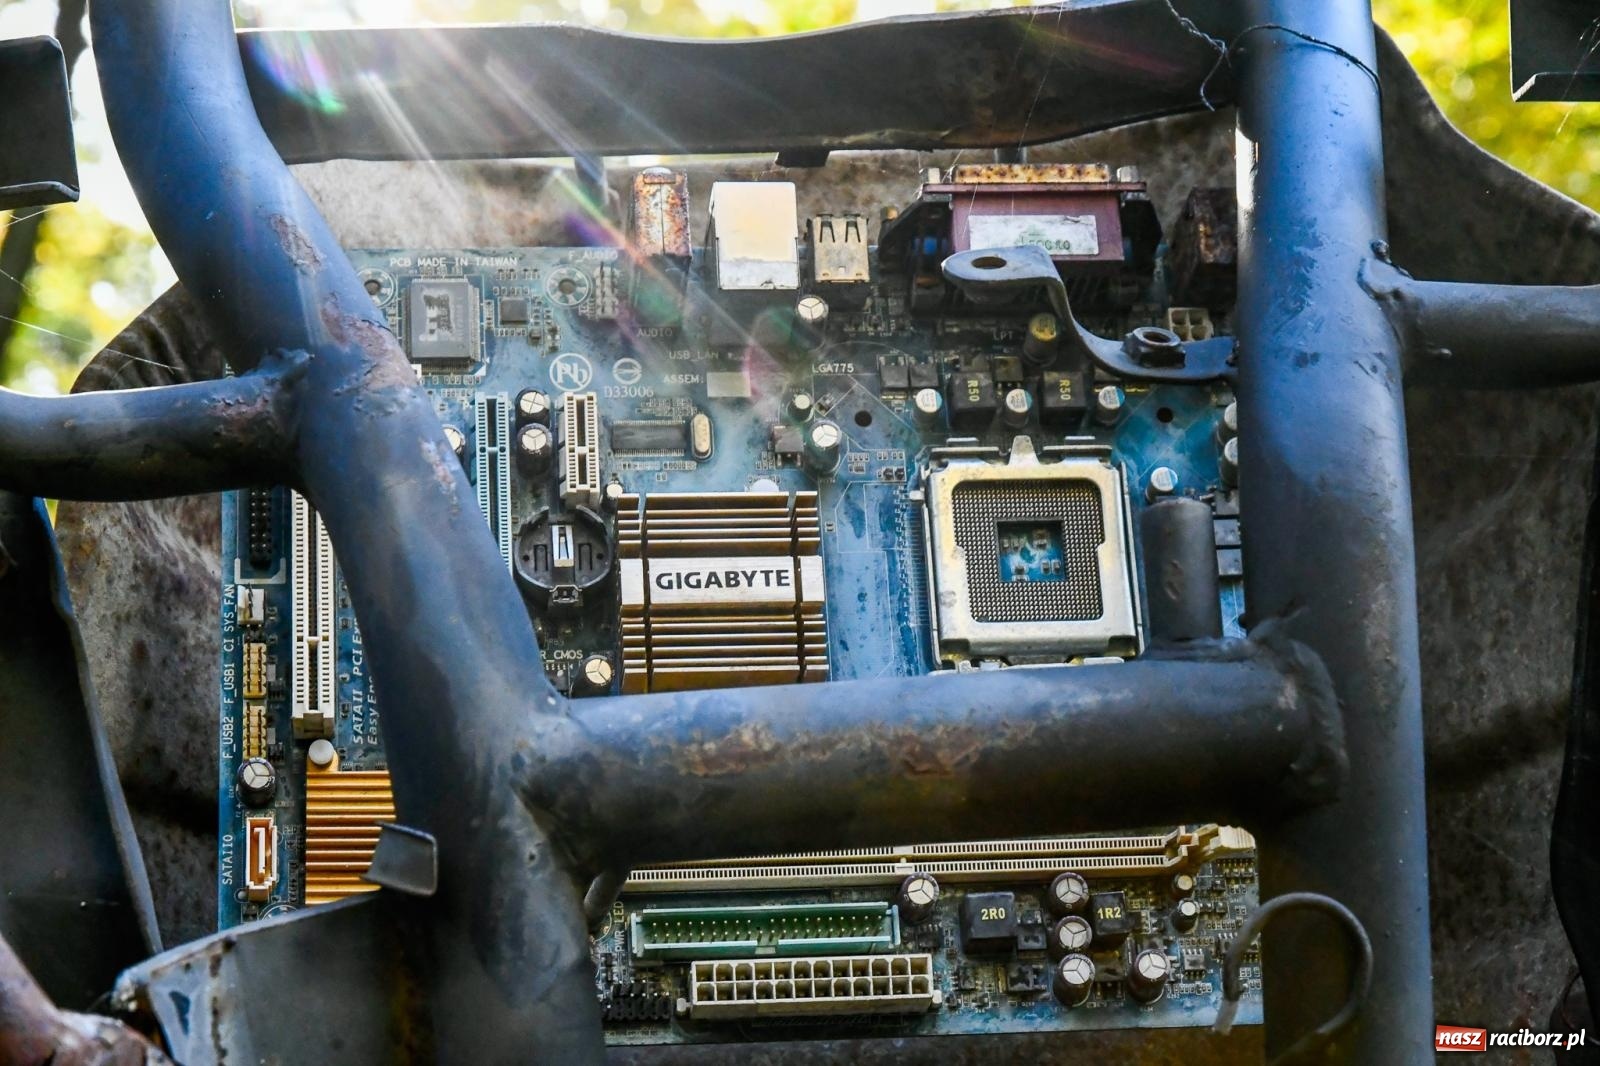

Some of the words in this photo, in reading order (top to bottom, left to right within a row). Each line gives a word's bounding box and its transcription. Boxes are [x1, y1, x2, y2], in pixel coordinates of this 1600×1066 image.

[390, 258, 411, 267] PCB
[417, 257, 447, 267] MADE
[455, 257, 468, 267] IN
[475, 257, 519, 267] TAIWAN
[637, 327, 673, 338] AUDIO
[812, 363, 854, 373] LGA775
[967, 380, 980, 402] R50
[1059, 379, 1071, 401] R50
[655, 569, 791, 590] GIGABYTE
[223, 583, 237, 633] SYS_FAN
[352, 647, 363, 676] PCI
[540, 649, 584, 663] R_CMOS
[223, 663, 236, 704] F_USB1
[352, 687, 364, 745] SATAII
[367, 707, 380, 746] Easy
[223, 716, 236, 759] F_USB2
[613, 901, 624, 923] LED
[980, 907, 1006, 921] 2R0
[1096, 906, 1122, 920] 1R2
[614, 930, 625, 953] PWR
